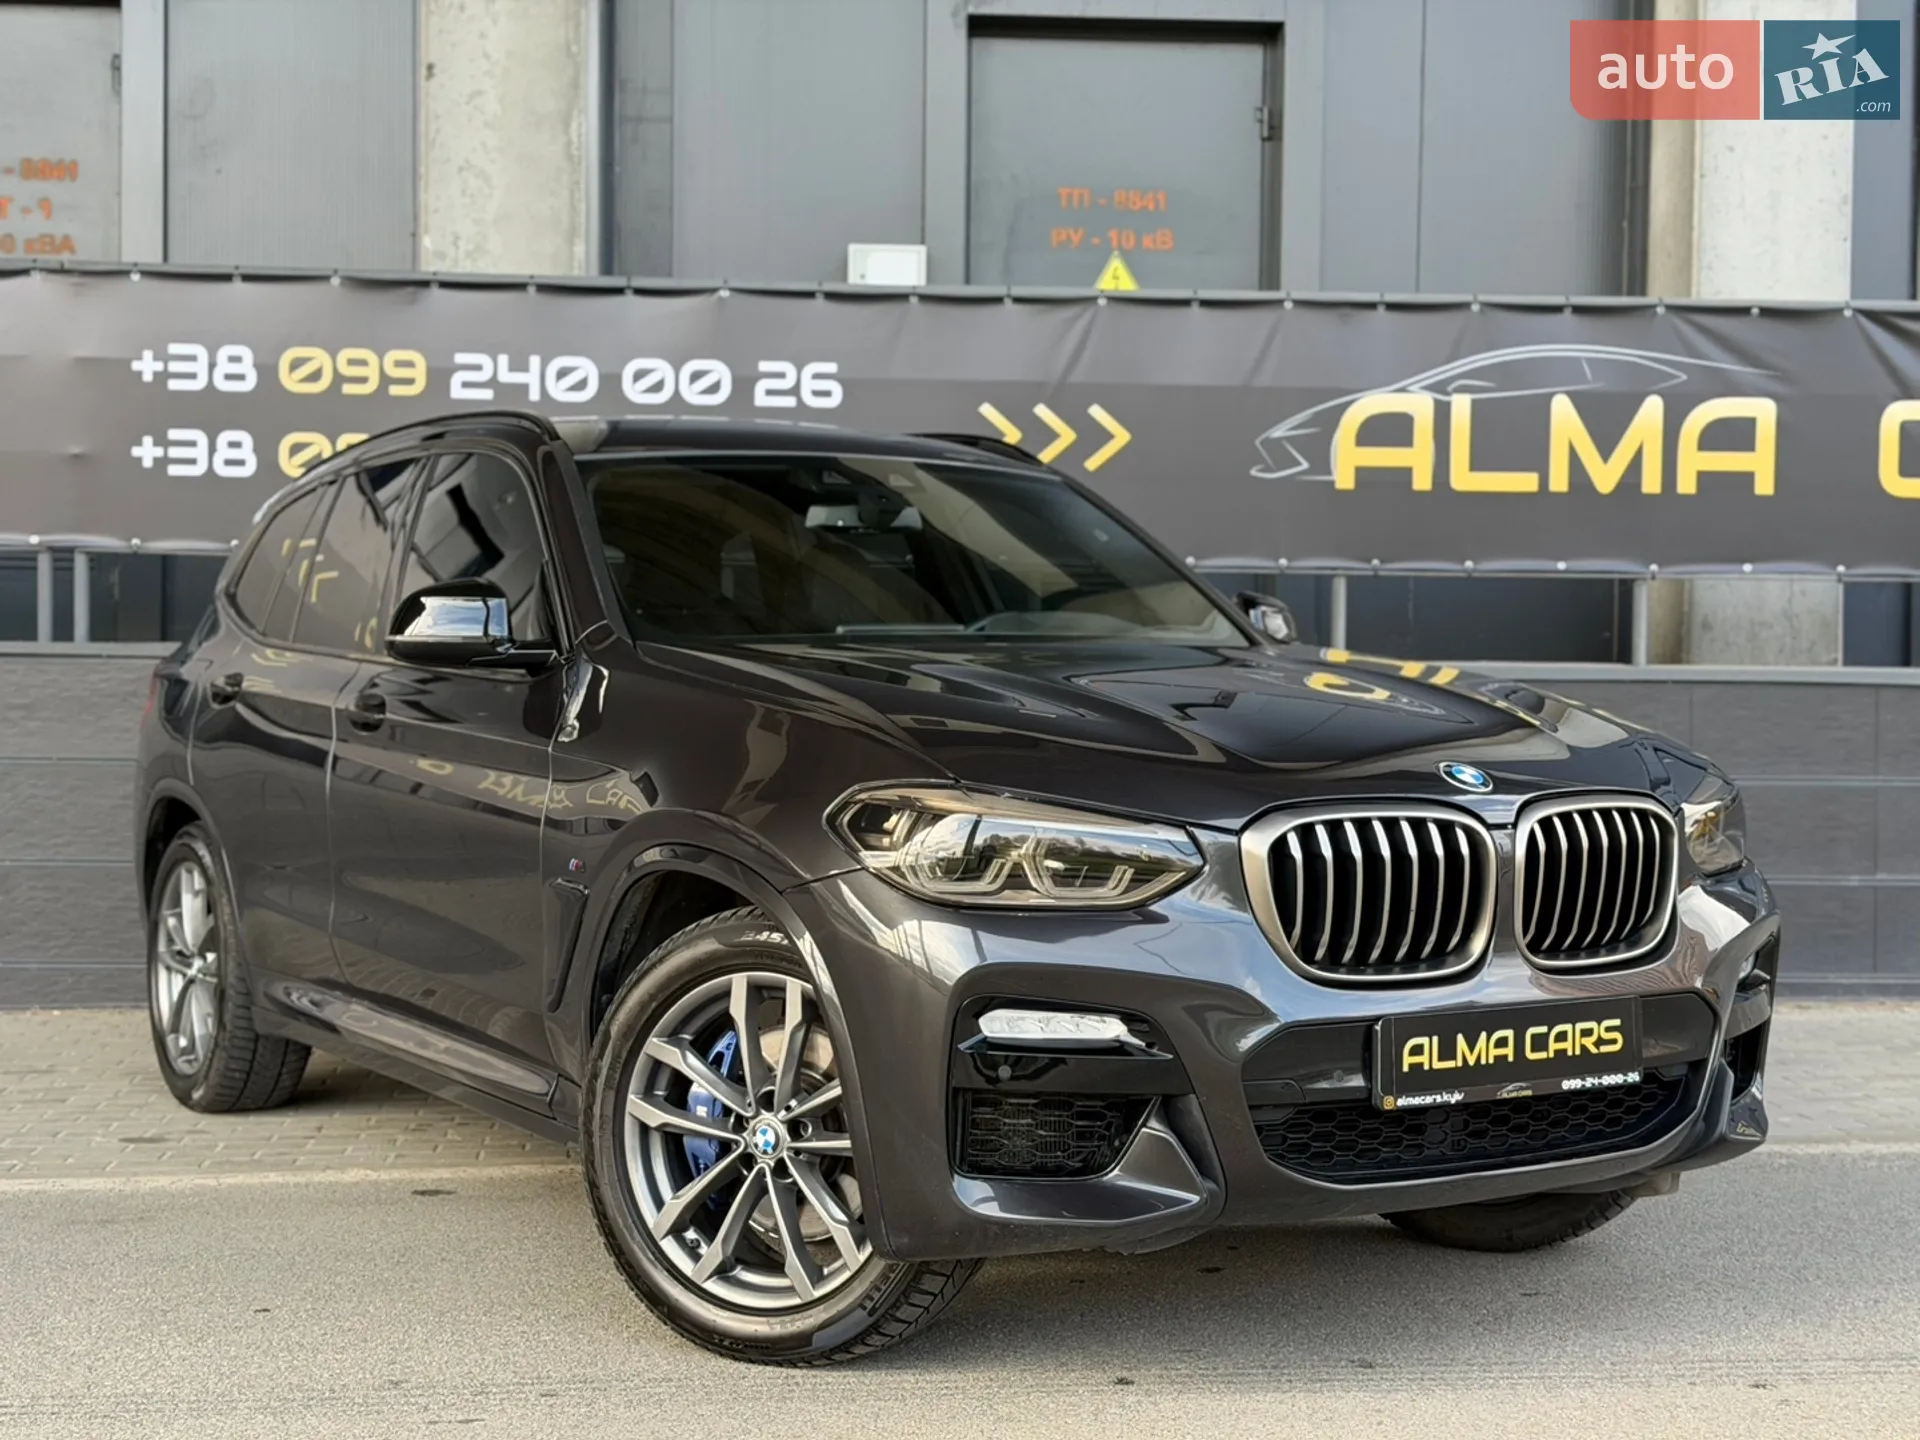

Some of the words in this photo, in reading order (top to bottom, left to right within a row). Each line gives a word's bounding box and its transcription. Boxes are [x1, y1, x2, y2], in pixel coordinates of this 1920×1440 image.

[1057, 187, 1091, 210] ТП
[1051, 227, 1085, 249] РУ
[1107, 228, 1137, 251] 10
[131, 342, 258, 392] +38
[278, 346, 427, 396] 099
[450, 352, 599, 402] 240
[621, 357, 732, 406] 00
[753, 360, 843, 409] 26
[131, 428, 257, 477] +38
[1334, 392, 1777, 495] ALMA
[1402, 1029, 1514, 1072] ALMA
[1525, 1019, 1623, 1060] CARS
